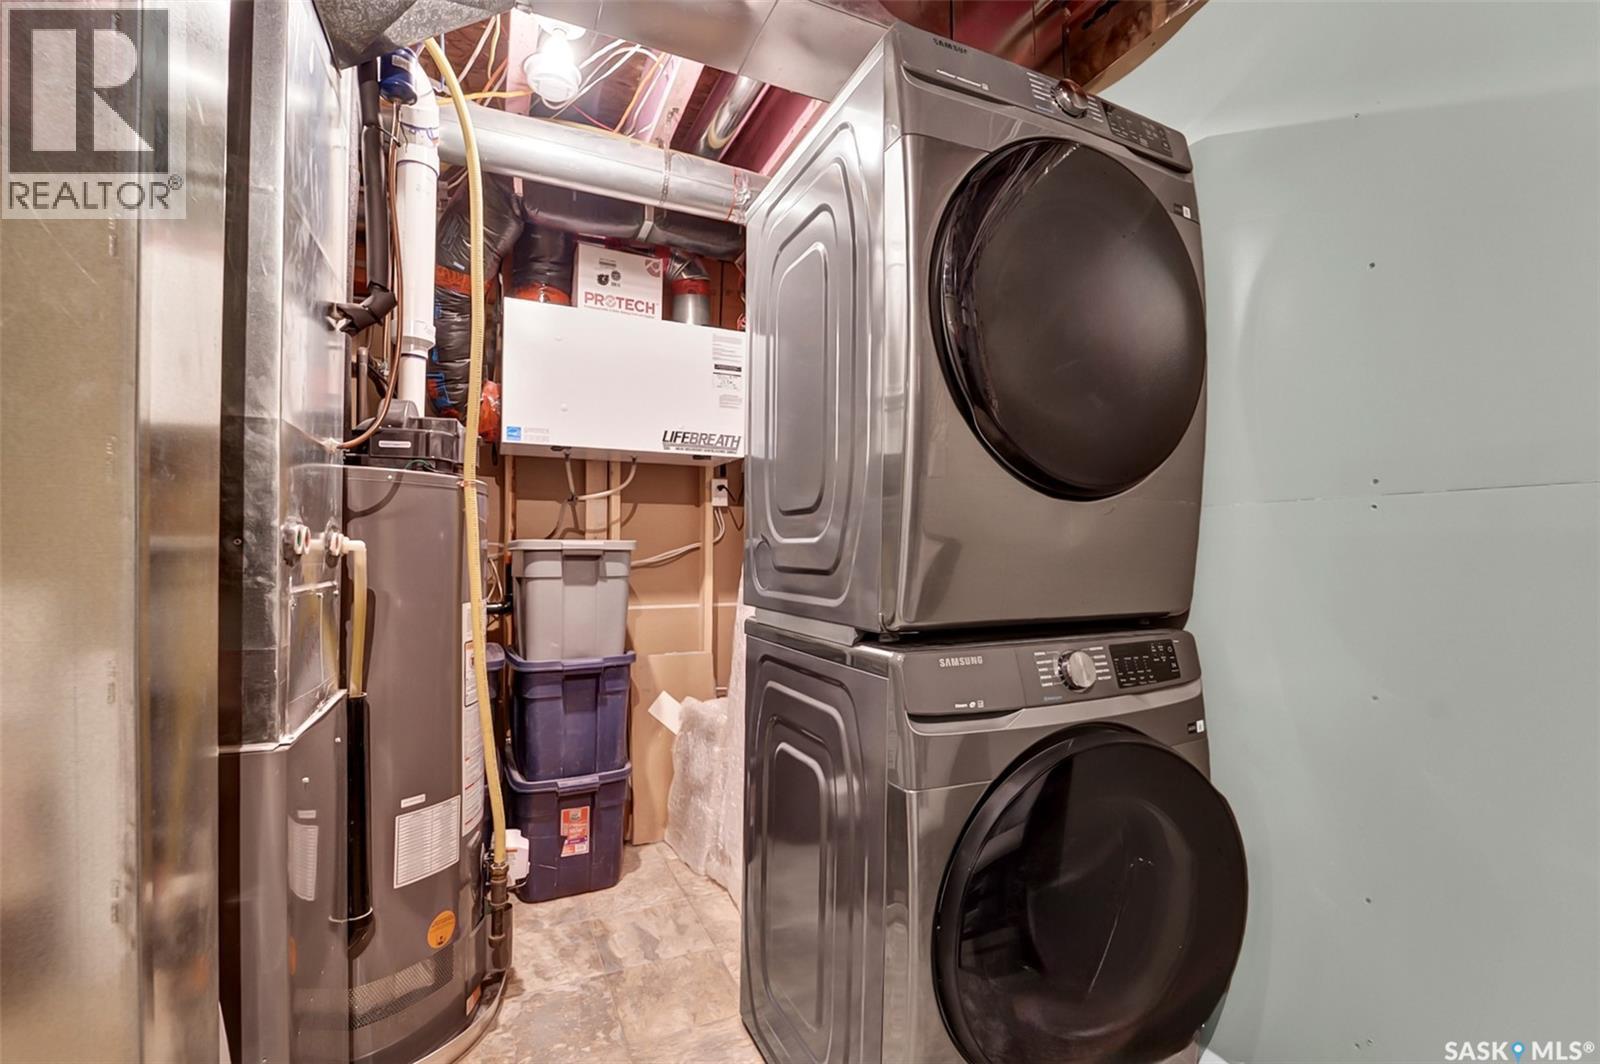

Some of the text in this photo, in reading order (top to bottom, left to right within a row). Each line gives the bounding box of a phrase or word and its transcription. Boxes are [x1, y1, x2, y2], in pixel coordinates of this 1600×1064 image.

[584, 291, 656, 315] PROTECH
[662, 430, 742, 449] LIFEBREATH
[939, 655, 983, 667] SAMSUNG
